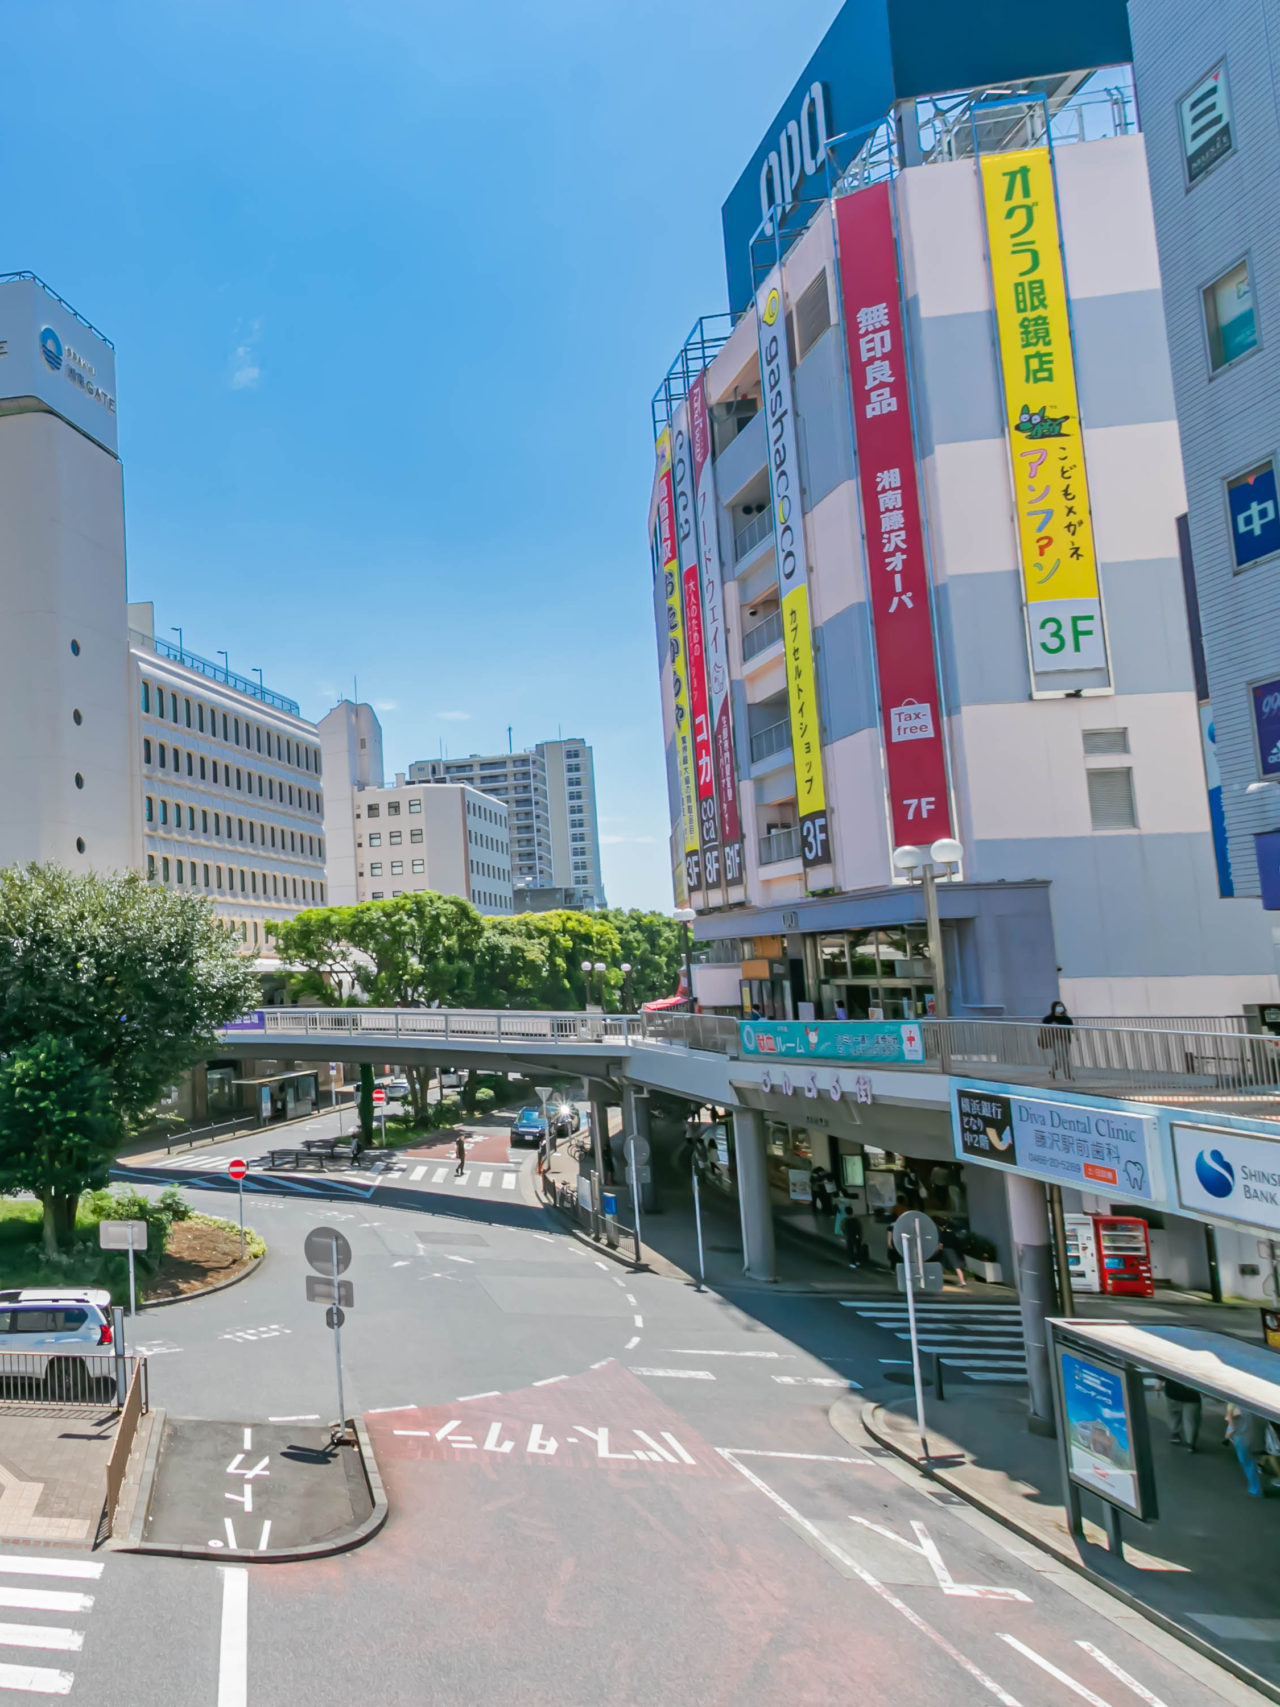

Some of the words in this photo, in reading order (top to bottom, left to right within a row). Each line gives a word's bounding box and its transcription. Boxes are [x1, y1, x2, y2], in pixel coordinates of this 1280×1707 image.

[1002, 165, 1055, 384] オグラ眼鏡店
[856, 302, 898, 418] 無印良品
[764, 335, 797, 581] gashacoco
[1019, 448, 1061, 585] アンファン
[1057, 446, 1085, 561] こどもメガネ
[1236, 498, 1276, 536] 中
[875, 467, 914, 613] 湘南藤沢オーパ
[1038, 614, 1095, 654] 3F
[788, 608, 814, 796] カプセルトイショップ
[895, 711, 928, 723] Tax-
[896, 723, 929, 736] free
[696, 713, 712, 786] コカ
[902, 796, 936, 820] 7F
[803, 817, 826, 861] 3F
[687, 853, 700, 889] 3F
[705, 849, 720, 885] 8F
[725, 842, 740, 881] B1F
[960, 1096, 1003, 1120] 横浜銀行
[962, 1116, 984, 1131] となり
[1018, 1104, 1046, 1127] Diva
[1049, 1109, 1092, 1135] Dental
[1095, 1118, 1137, 1143] Clinic
[963, 1133, 990, 1151] 中2階
[1033, 1129, 1120, 1164] 藤沢駅前歯科
[1243, 1184, 1279, 1206] BANK
[393, 1419, 697, 1466] バス・タクシー
[206, 1426, 272, 1551] パトカー
